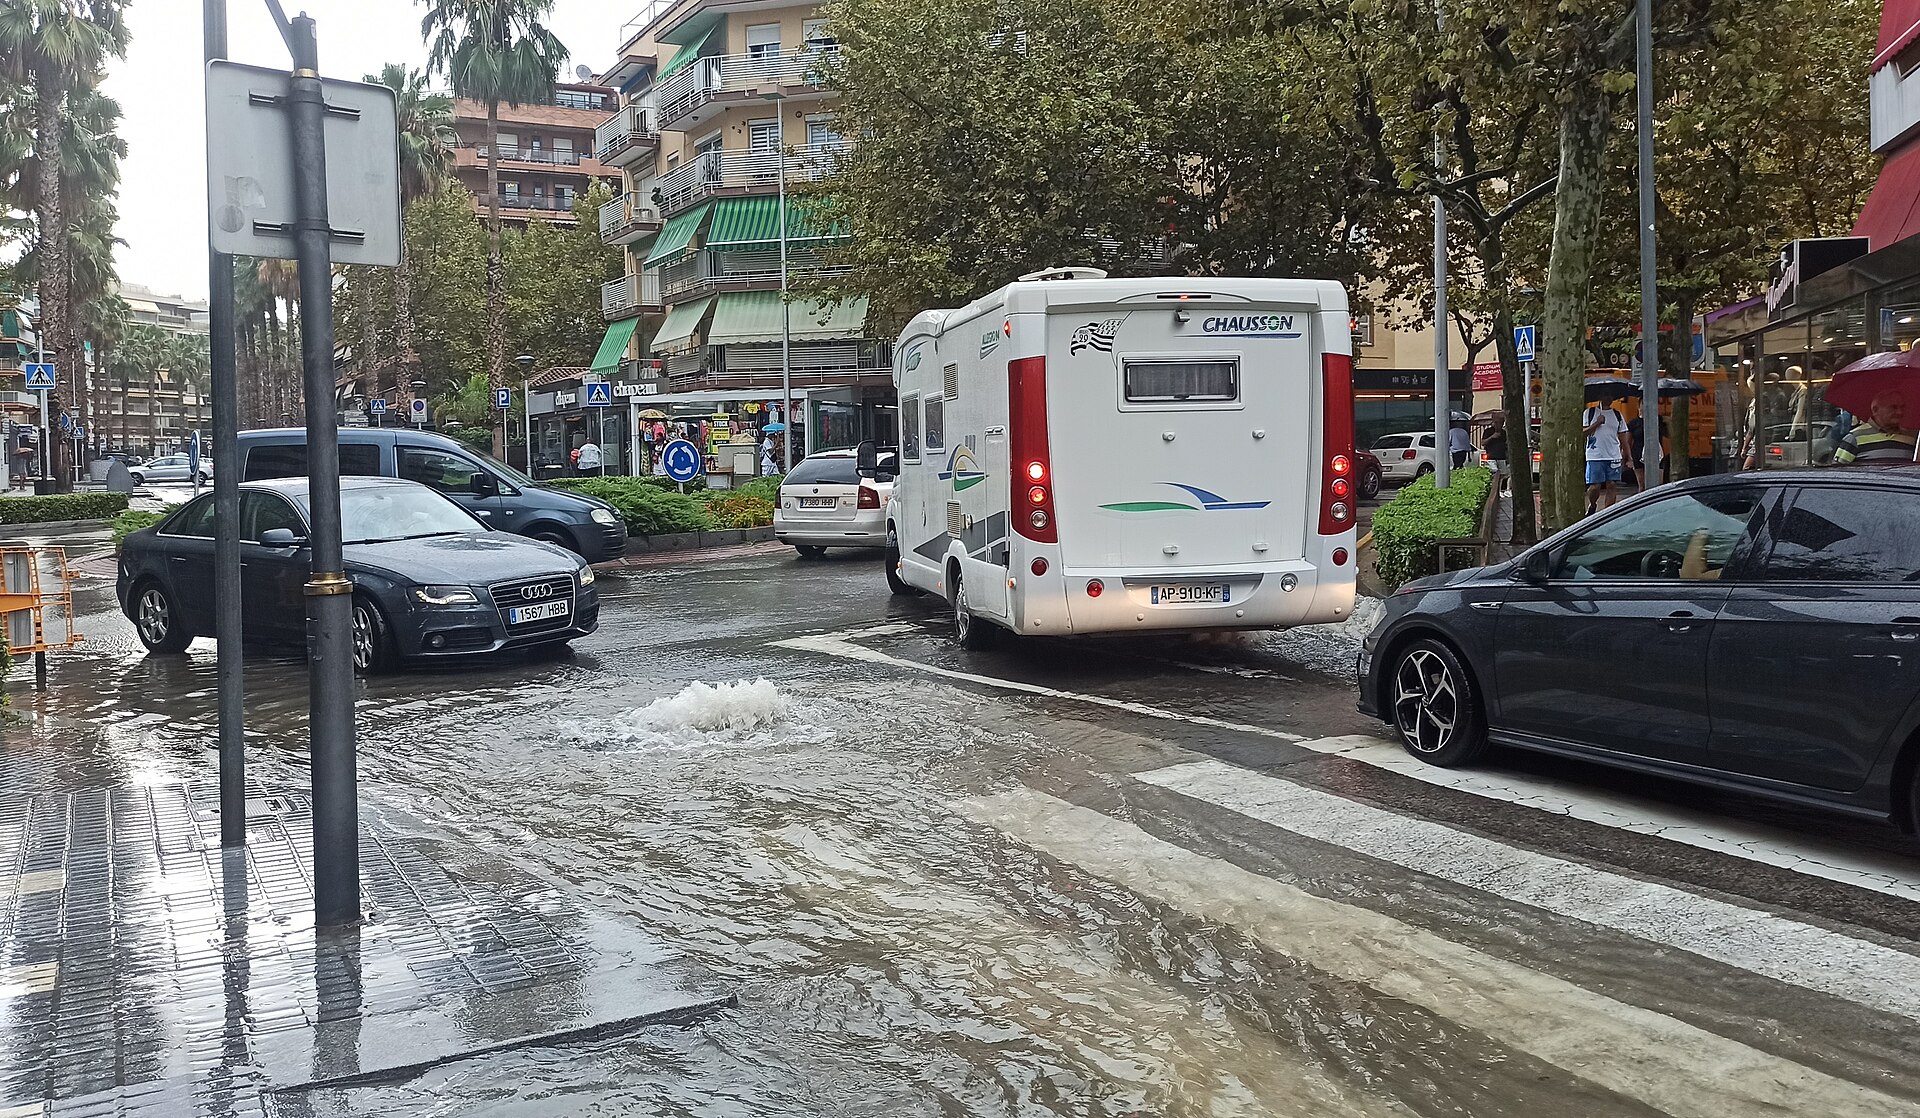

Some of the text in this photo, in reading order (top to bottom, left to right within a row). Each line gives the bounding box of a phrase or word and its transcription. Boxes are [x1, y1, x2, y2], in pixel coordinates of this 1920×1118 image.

[1202, 315, 1294, 332] CHAUSSON
[1160, 586, 1221, 600] AP-910-KF
[520, 602, 566, 620] 1567 HBB
